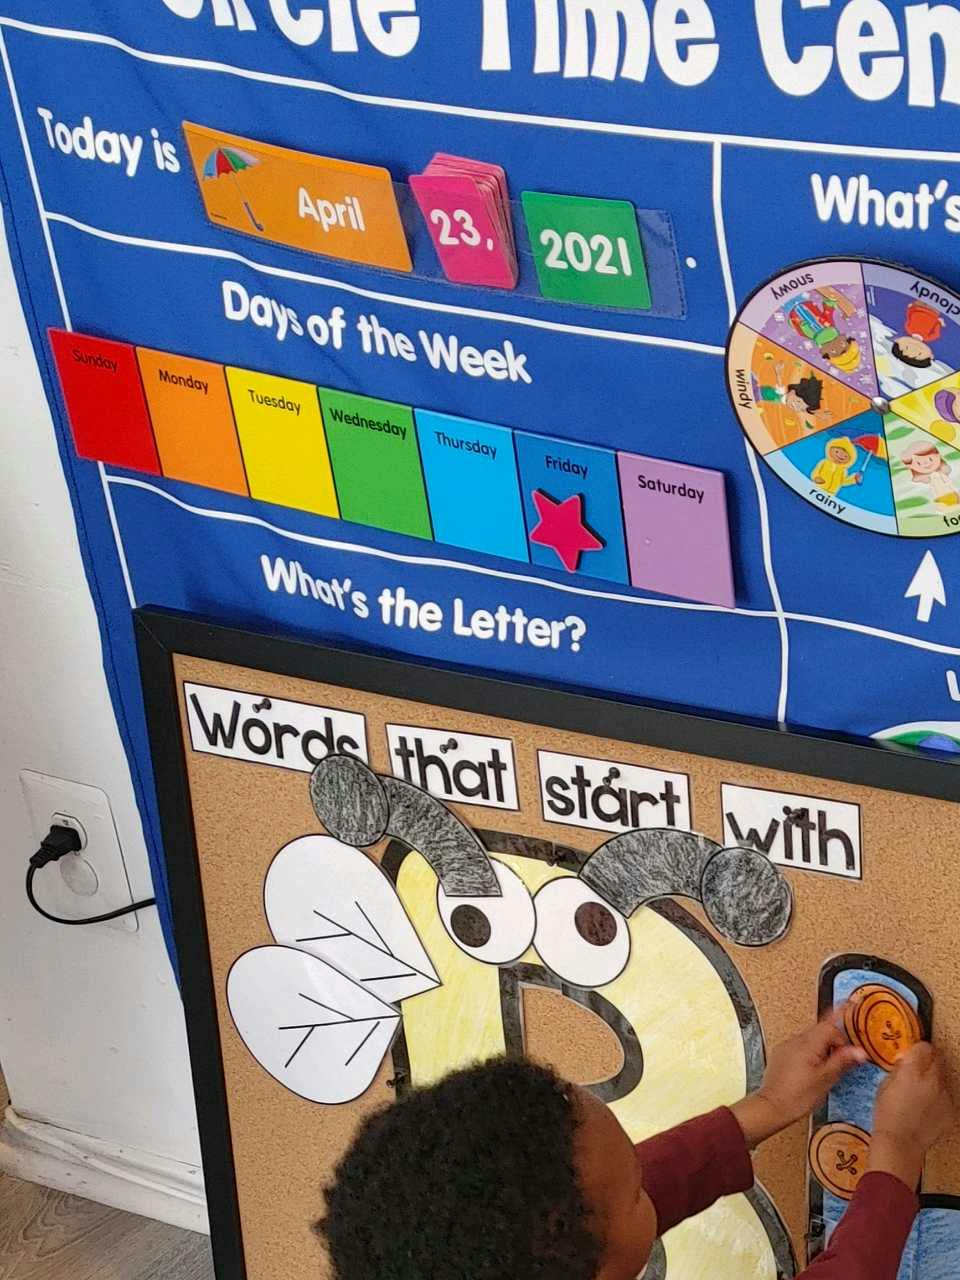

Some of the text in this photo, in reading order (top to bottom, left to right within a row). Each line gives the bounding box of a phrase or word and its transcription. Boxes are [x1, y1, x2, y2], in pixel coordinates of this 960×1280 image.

[37, 107, 180, 177] Today is
[298, 186, 366, 232] April
[540, 229, 633, 276] 2021
[770, 273, 815, 300] snowy
[909, 280, 960, 316] cloudy
[222, 280, 533, 384] Days of the Week
[73, 350, 117, 373] Sunday
[158, 369, 209, 395] Monday
[734, 368, 752, 409] windy
[248, 389, 301, 416] Tuesday
[329, 407, 407, 440] Wednesday
[434, 431, 497, 460] Thursday
[545, 455, 588, 480] Friday
[637, 474, 704, 504] Saturday
[808, 487, 846, 515] rainy
[260, 554, 586, 652] What's the Letter?
[394, 735, 507, 802] that
[544, 765, 680, 828] start
[725, 805, 855, 870] with
